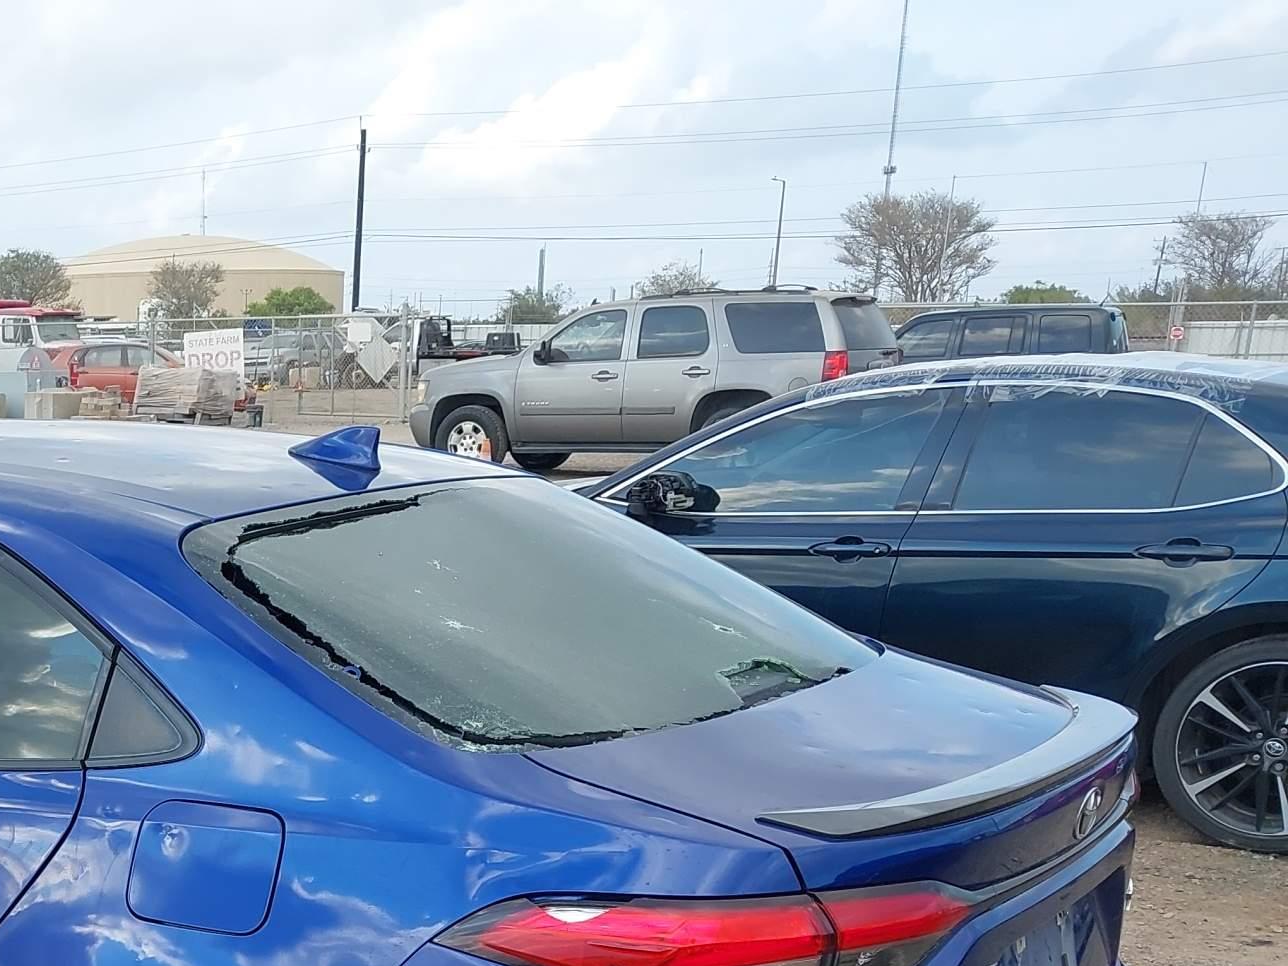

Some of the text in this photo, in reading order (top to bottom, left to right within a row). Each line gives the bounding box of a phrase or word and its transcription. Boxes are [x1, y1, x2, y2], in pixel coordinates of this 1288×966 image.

[188, 336, 240, 348] STATE FARM
[187, 350, 242, 369] DROP
